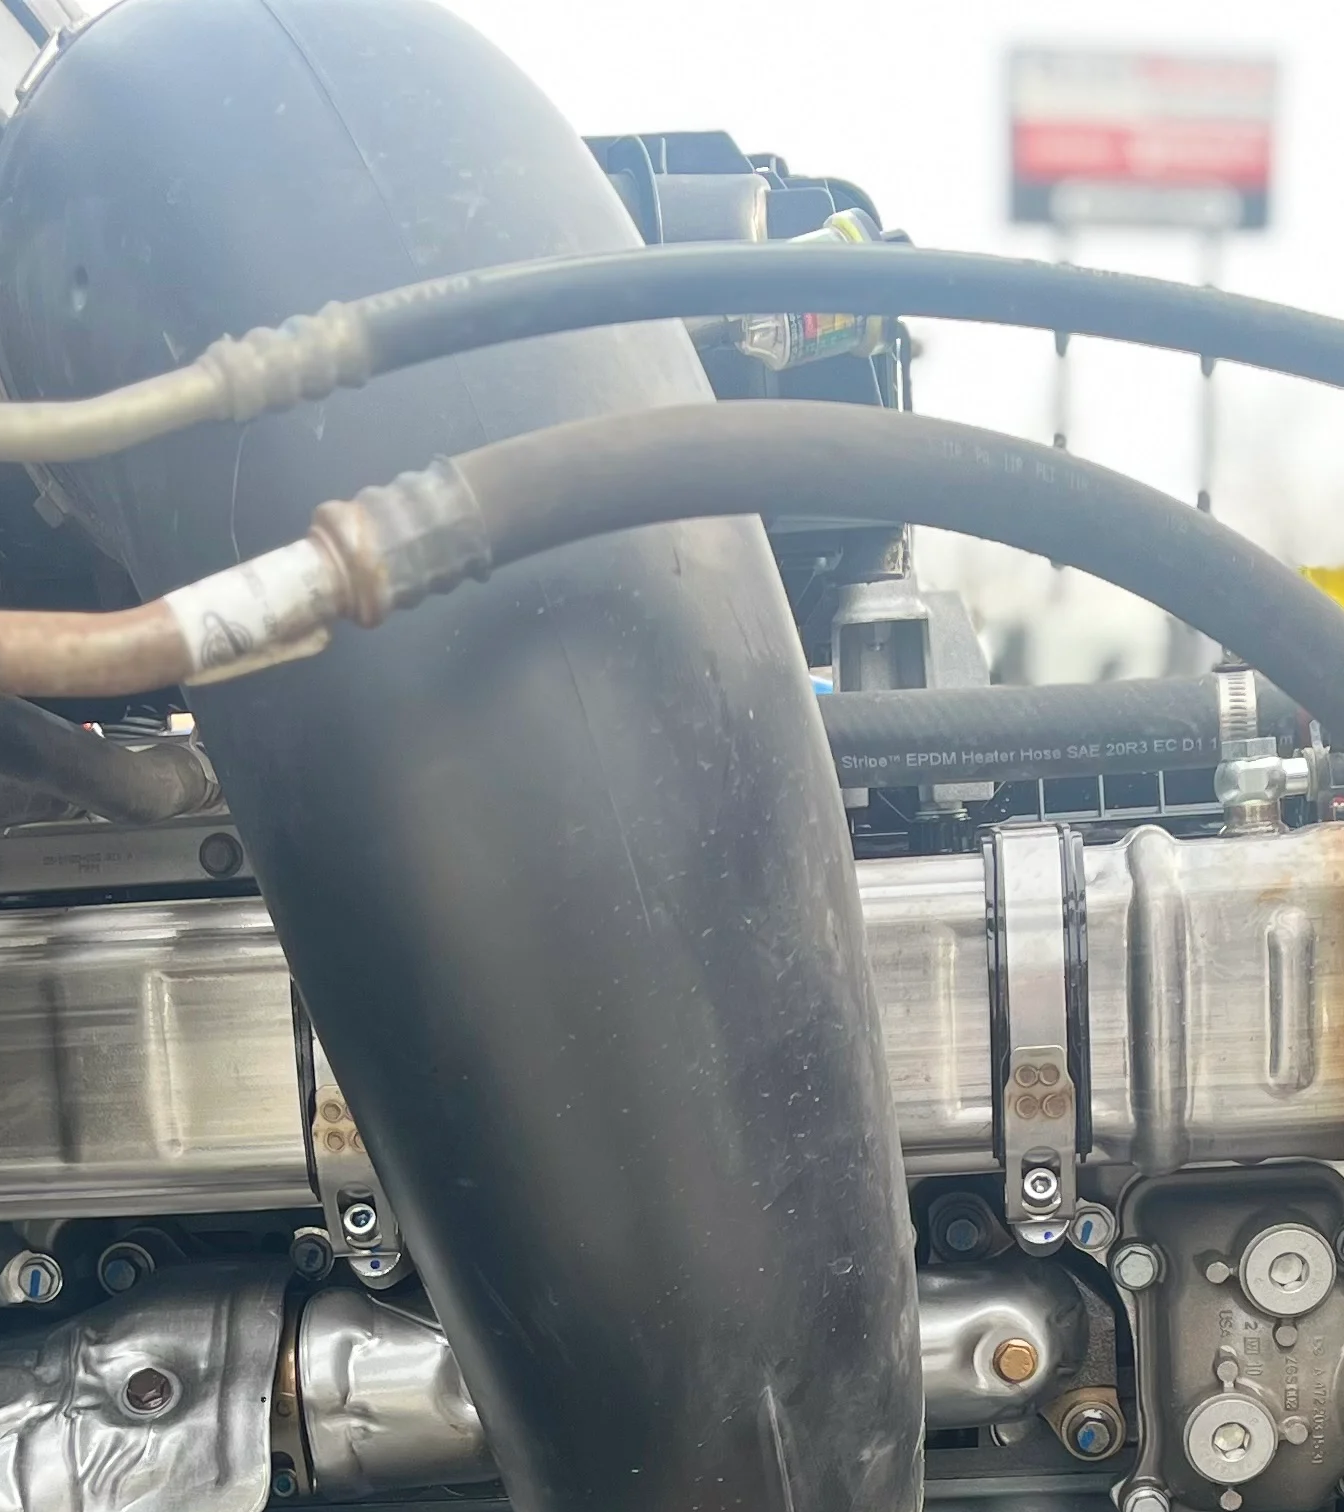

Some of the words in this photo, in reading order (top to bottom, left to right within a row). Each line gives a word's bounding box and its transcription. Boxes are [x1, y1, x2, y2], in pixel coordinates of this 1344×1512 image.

[906, 752, 957, 768] EPDM
[961, 749, 1017, 765] Heater
[1020, 747, 1062, 762] Hose
[1066, 743, 1100, 759] SAE
[1105, 740, 1148, 756] 20R3
[1153, 738, 1177, 754] EC
[1182, 736, 1203, 752] D1
